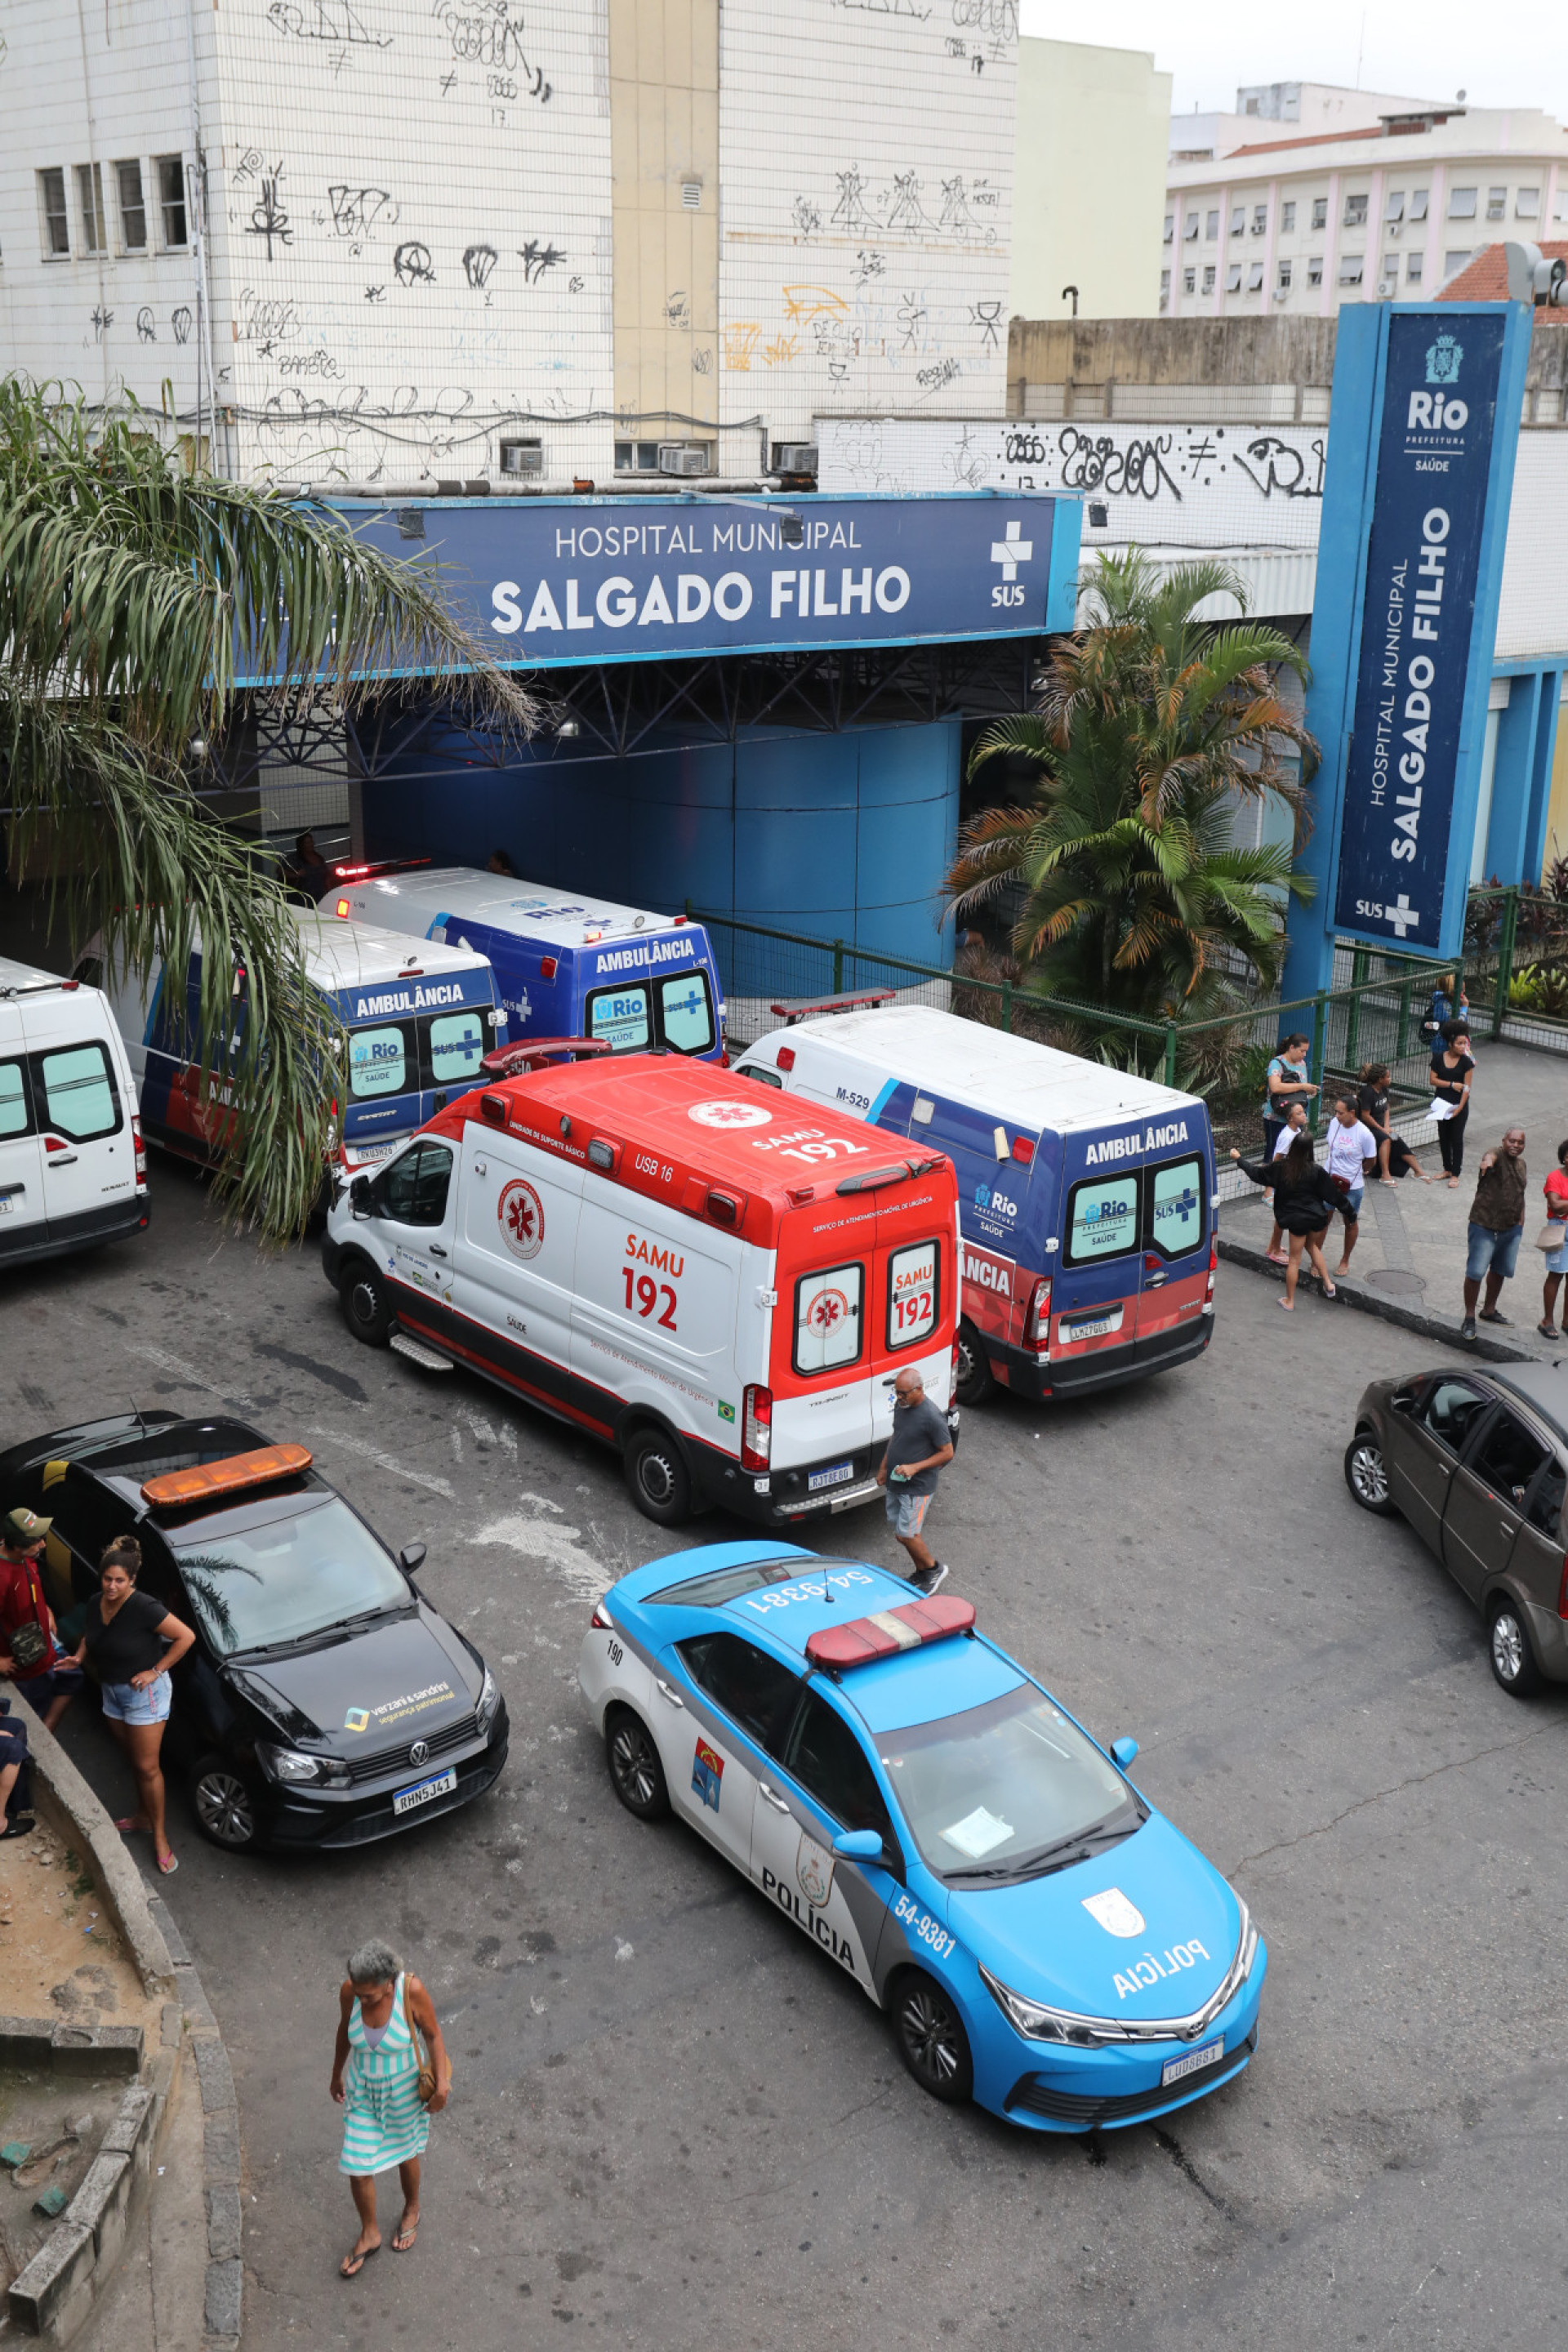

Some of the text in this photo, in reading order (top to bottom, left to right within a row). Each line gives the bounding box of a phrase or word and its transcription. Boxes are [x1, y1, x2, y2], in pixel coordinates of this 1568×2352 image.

[1407, 391, 1468, 430] Rio
[1405, 435, 1465, 444] PREFEITURA
[1415, 457, 1450, 472] SAÚDE
[555, 525, 703, 558] HOSPITAL
[490, 565, 911, 635] SALGADO FILHO
[991, 585, 1026, 608] SUS
[1370, 559, 1409, 806] HOSPITAL MUNICIPAL
[1391, 506, 1450, 863] SALGADO FILHO
[1356, 899, 1383, 919] SUS
[595, 938, 695, 973] AMBULÂNCIA
[357, 983, 464, 1018] AMBULÂNCIA
[613, 999, 643, 1018] Rio
[372, 1043, 399, 1059] Rio
[365, 1071, 390, 1083] SAÚDE
[836, 1087, 870, 1109] M-529
[509, 1120, 586, 1159] UNIDADE DE SUPORTE BÁSICO
[751, 1129, 826, 1150] SAMU
[779, 1138, 870, 1164] 192
[1085, 1121, 1189, 1166] AMBULÂNCIA
[635, 1153, 674, 1183] USB 16
[991, 1191, 1018, 1217] Rio
[1100, 1200, 1128, 1217] Rio
[1156, 1204, 1174, 1221] SUS
[813, 1220, 837, 1233] SERVIÇO
[837, 1219, 845, 1227] DE
[845, 1209, 883, 1225] ATENDIMENTO
[980, 1221, 1004, 1238] SAÚDE
[1091, 1233, 1117, 1246] SAÚDE
[625, 1233, 685, 1279] SAMU
[895, 1263, 933, 1290] SAMU
[621, 1266, 678, 1333] 192
[895, 1292, 933, 1330] 192
[745, 1570, 875, 1614] 54-9381
[607, 1639, 623, 1666] 190
[371, 1696, 408, 1716] verzani
[413, 1681, 450, 1701] sandrini
[379, 1690, 455, 1725] segurança patrimonial
[400, 1777, 451, 1811] RHN5J41
[761, 1866, 855, 1971] POLÍCIA
[894, 1894, 956, 1959] 54-9381
